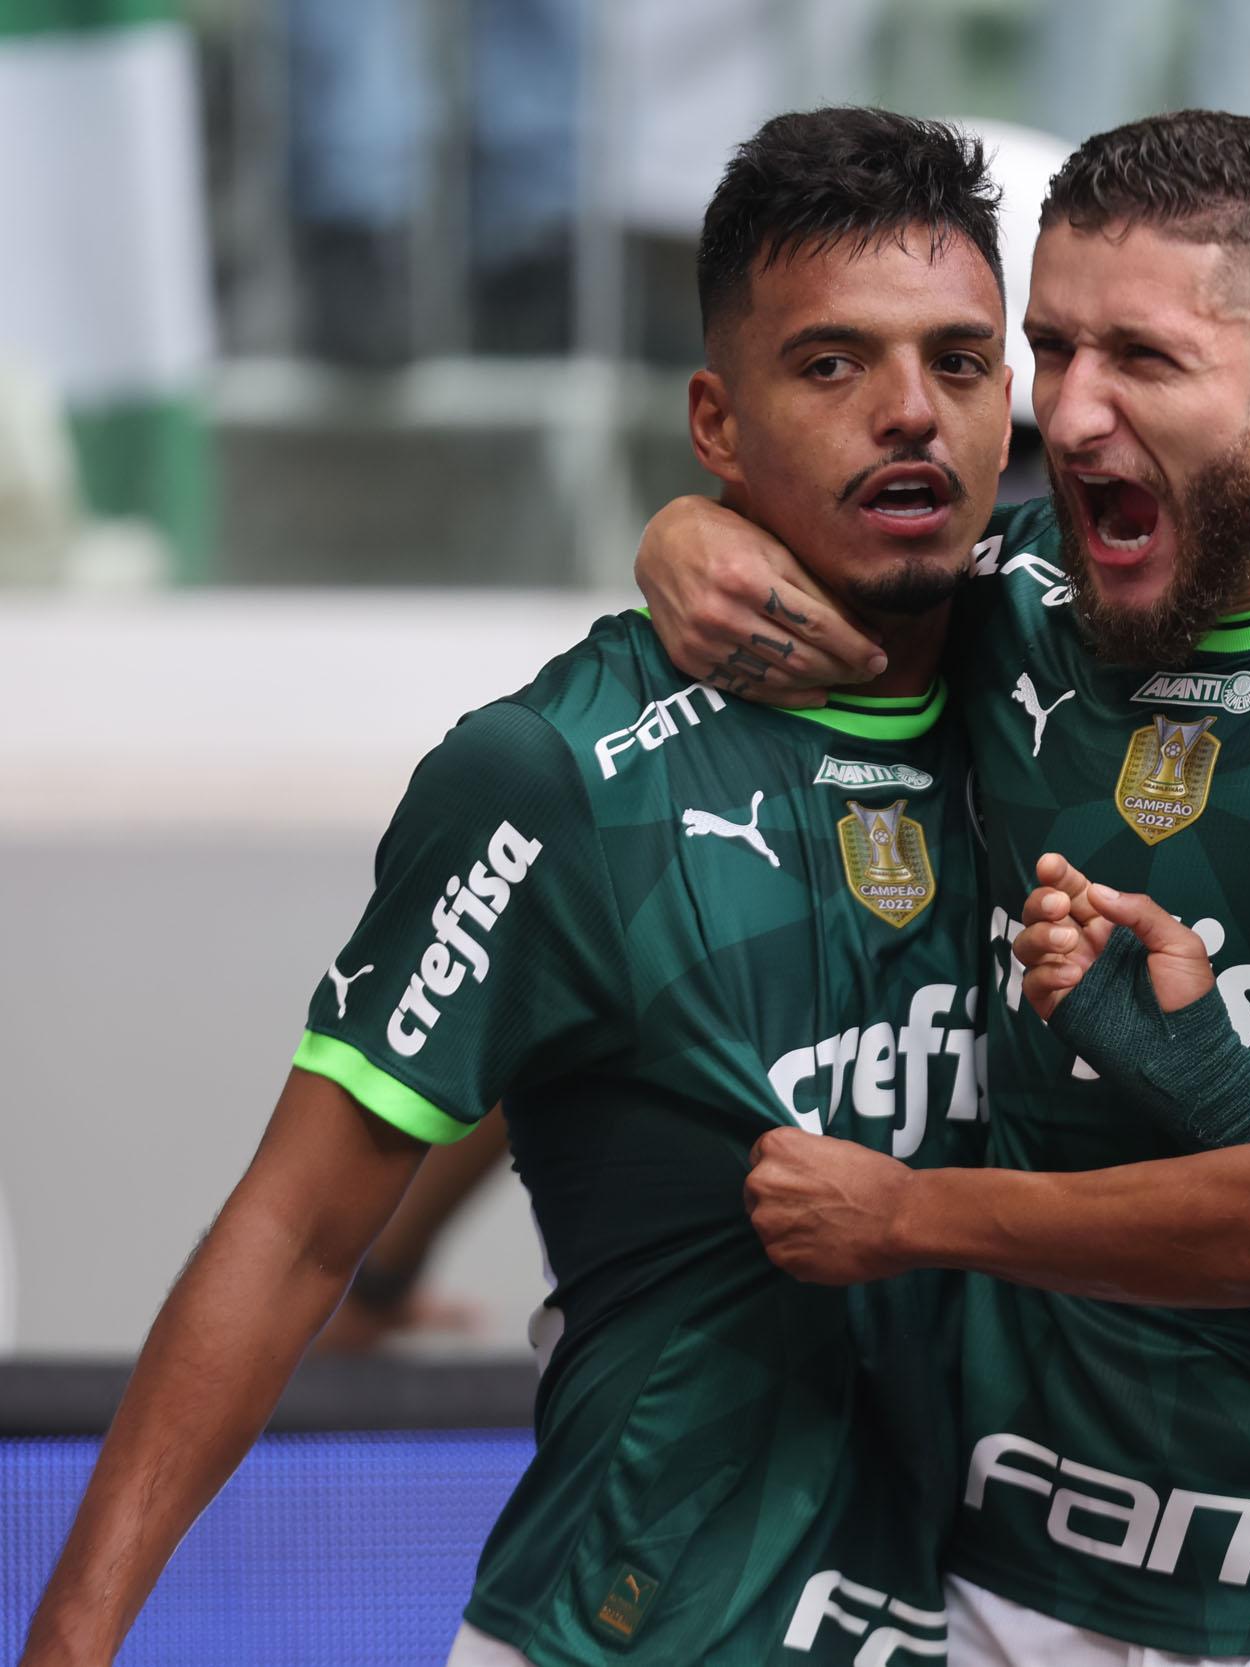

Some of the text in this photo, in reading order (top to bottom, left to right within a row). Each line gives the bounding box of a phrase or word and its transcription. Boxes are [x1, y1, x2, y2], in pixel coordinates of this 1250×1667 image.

[1143, 677, 1222, 701] AVANTI
[825, 761, 894, 784] AVANTI
[1124, 796, 1193, 816] CAMPEÃO
[1136, 813, 1174, 828] 2022
[860, 885, 926, 897] CAMPEÃO
[878, 899, 913, 910] 2022
[386, 820, 544, 1057] crefisa
